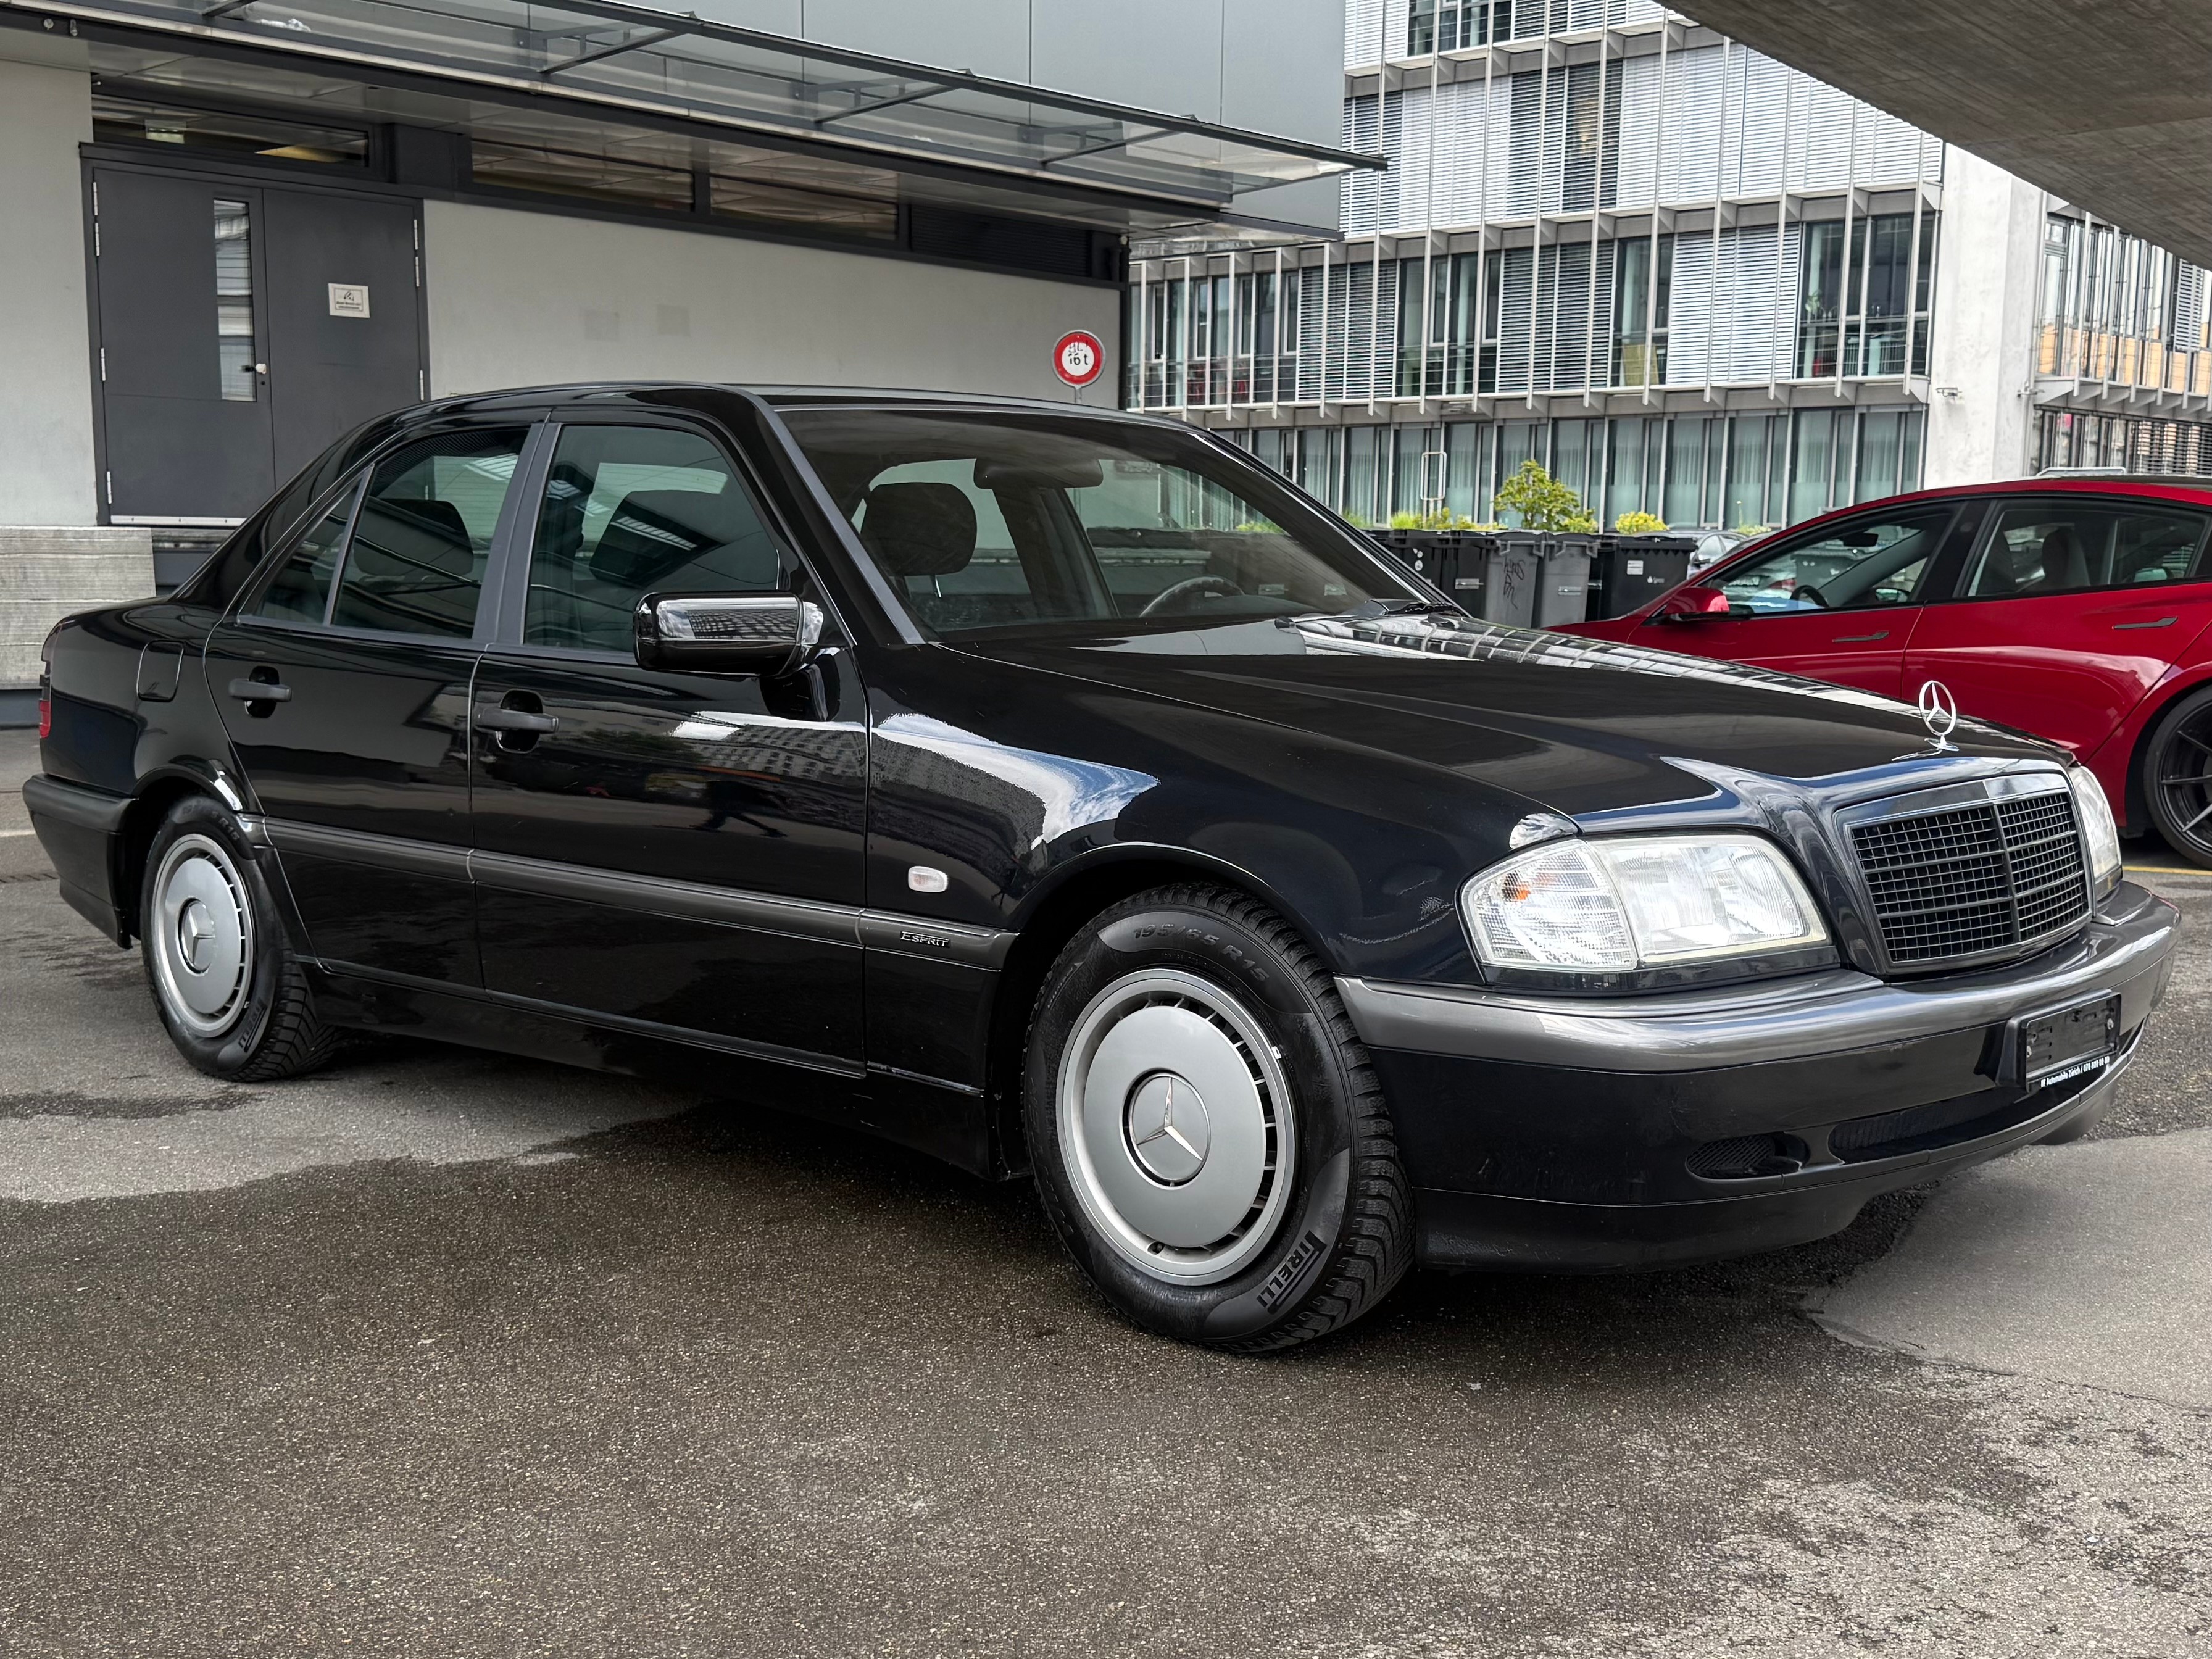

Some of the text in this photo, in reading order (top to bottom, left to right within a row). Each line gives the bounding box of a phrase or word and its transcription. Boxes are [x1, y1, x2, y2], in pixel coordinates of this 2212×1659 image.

[900, 931, 949, 947] ESPRIT
[1134, 923, 1220, 946] 195/65
[1255, 1229, 1328, 1315] PIRELLI
